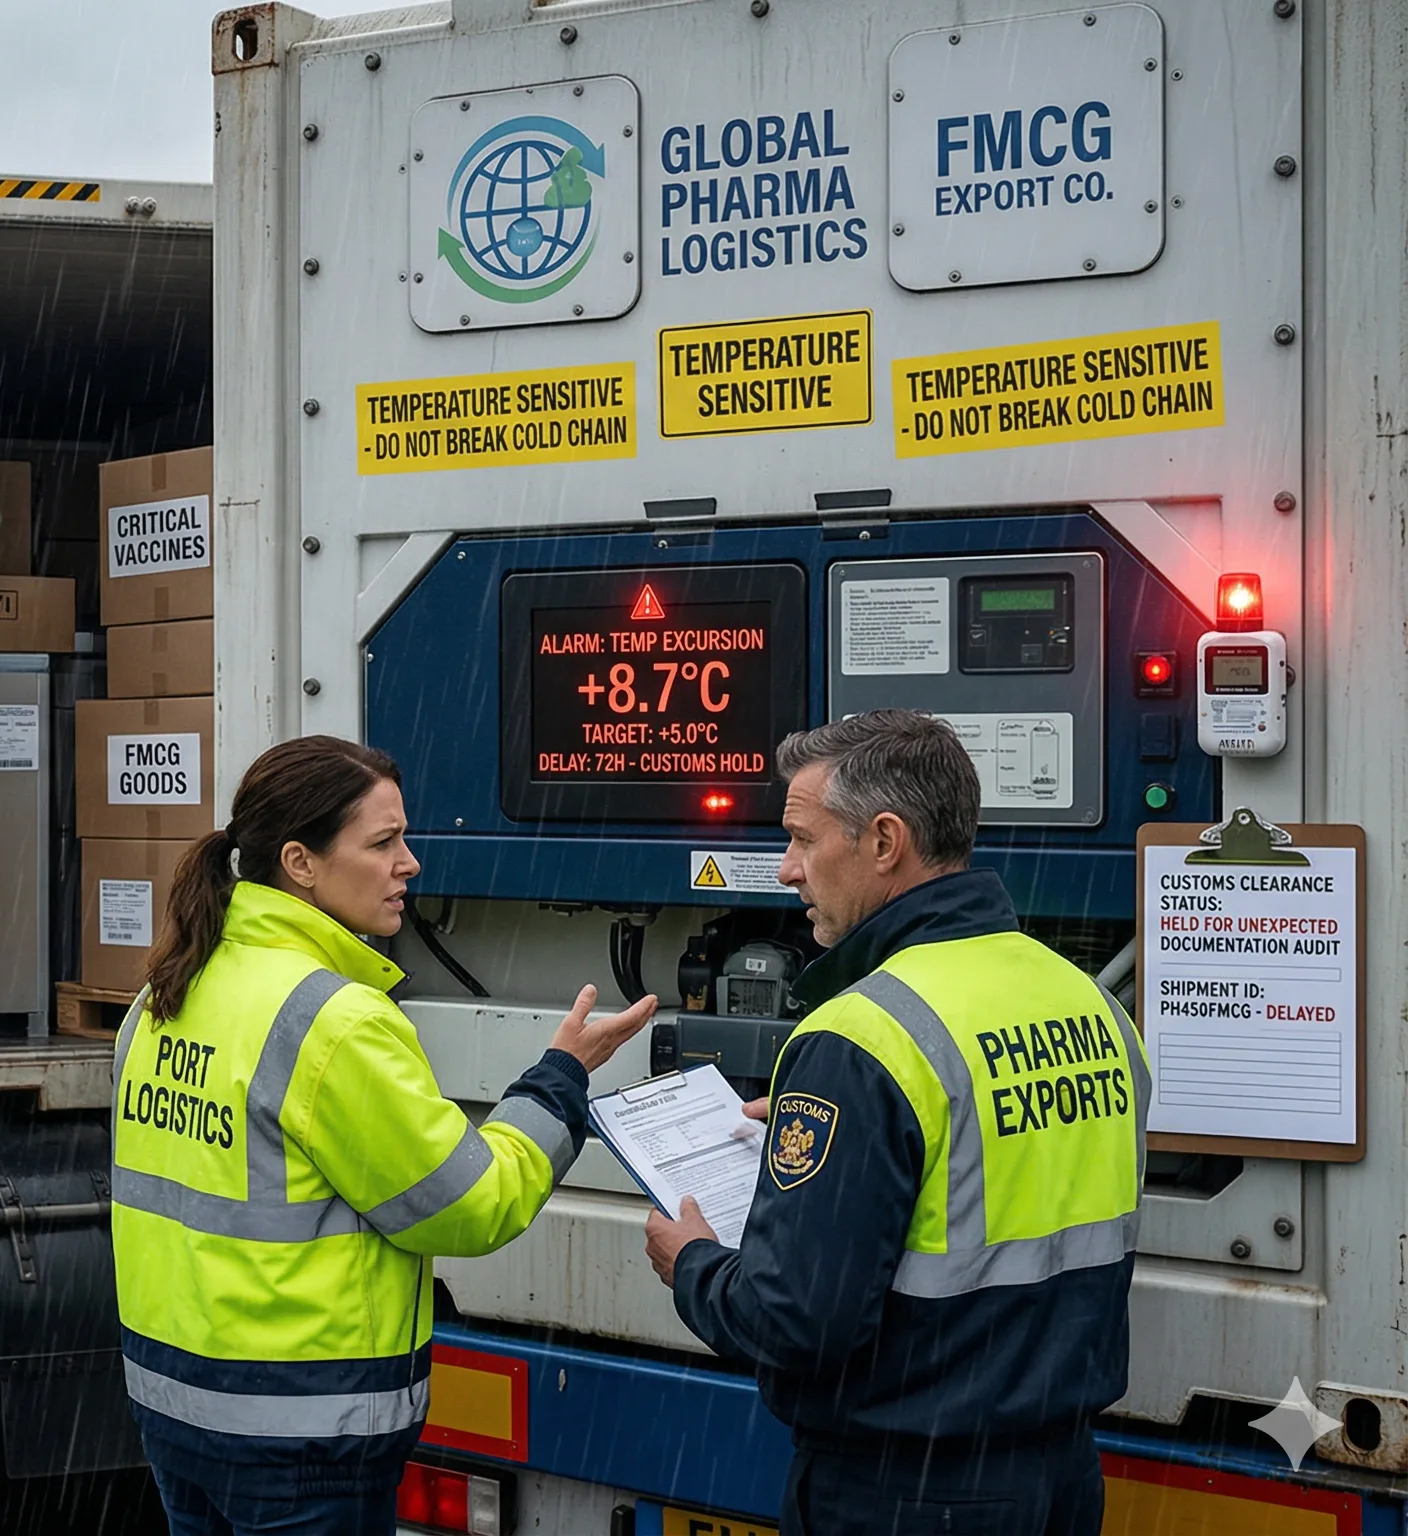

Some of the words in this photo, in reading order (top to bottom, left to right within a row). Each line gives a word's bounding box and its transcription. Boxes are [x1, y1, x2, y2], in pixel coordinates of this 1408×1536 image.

[661, 109, 849, 175] GLOBAL
[938, 101, 1111, 177] FMCG
[662, 167, 855, 228] PHARMA
[936, 176, 1054, 216] EXPORT
[1064, 172, 1113, 203] CO.
[662, 217, 867, 276] LOGISTICS
[670, 330, 860, 376] TEMPERATURE
[907, 354, 1076, 402] TEMPERATURE
[1084, 338, 1208, 382] SENSITIVE
[367, 386, 511, 424] TEMPERATURE
[517, 377, 622, 413] SENSITIVE
[699, 375, 831, 417] SENSITIVE
[915, 411, 943, 440] DO
[950, 405, 992, 437] NOT
[999, 396, 1072, 432] BREAK
[1078, 390, 1135, 423] COLD
[1143, 381, 1212, 416] CHAIN
[376, 433, 399, 459] DO
[406, 430, 441, 457] NOT
[447, 425, 508, 455] BREAK
[513, 421, 561, 450] COLD
[568, 416, 626, 446] CHAIN
[118, 507, 201, 538] CRITICAL
[114, 535, 204, 566] VACCINES
[541, 633, 604, 654] ALARM:
[610, 632, 657, 652] TEMP
[663, 629, 763, 651] EXCURSION
[579, 661, 729, 713] +8.7°C
[126, 743, 179, 766] FMCG
[583, 723, 652, 744] TARGET:
[659, 723, 717, 743] +5.0°C
[120, 772, 186, 794] GOODS
[540, 753, 590, 771] DELAY:
[596, 753, 624, 771] 72H
[641, 753, 716, 772] CUSTOMS
[721, 753, 763, 772] HOLD
[1161, 875, 1235, 890] CUSTOMS
[1241, 876, 1333, 892] CLEARANCE
[1161, 895, 1221, 911] STATUS:
[1161, 916, 1199, 931] HELD
[1205, 917, 1233, 932] FOR
[1239, 918, 1337, 934] UNEXPECTED
[1161, 936, 1288, 954] DOCUMENTATION
[1294, 940, 1340, 955] AUDIT
[1161, 980, 1239, 997] SHIPMENT
[1245, 983, 1264, 998] ID:
[1161, 1001, 1251, 1019] PH450FMCG
[1267, 1005, 1335, 1022] DELAYED
[155, 1035, 215, 1088] PORT
[976, 1014, 1120, 1079] PHARMA
[123, 1079, 233, 1149] LOGISTICS
[781, 1100, 831, 1123] CUSTOMS
[991, 1068, 1128, 1137] EXPORTS
